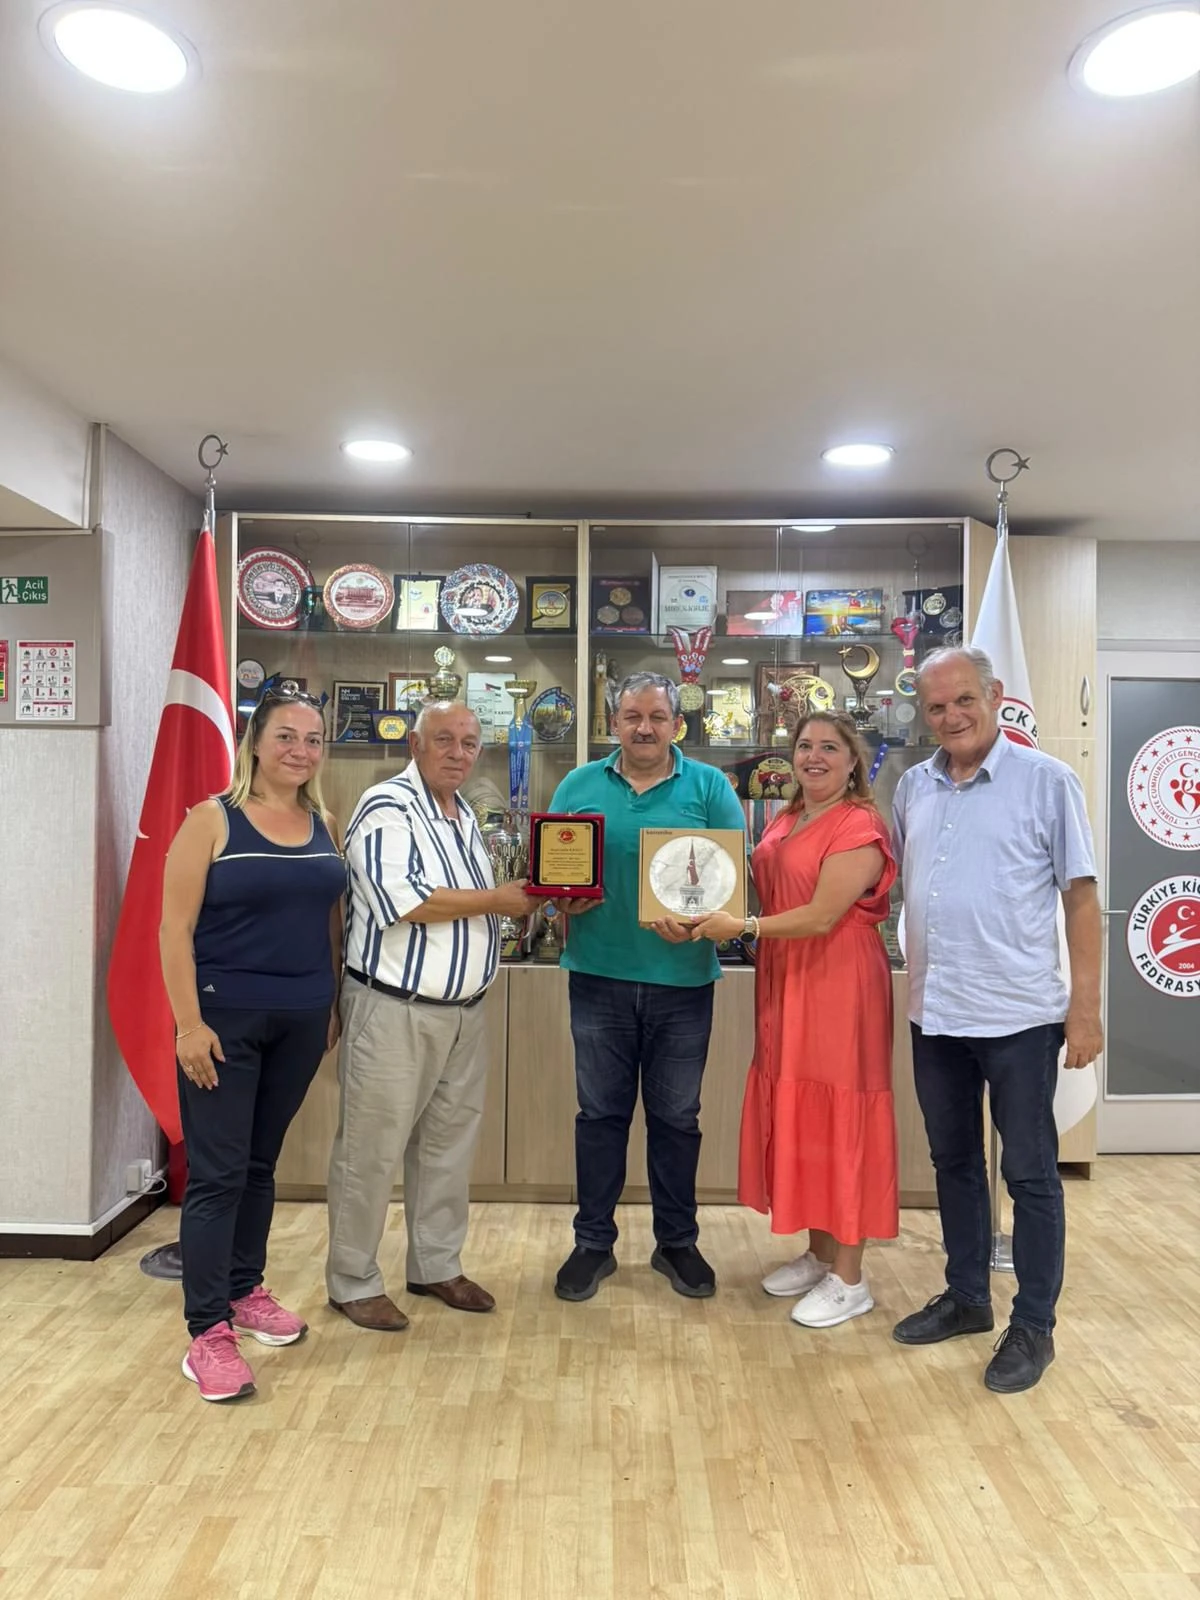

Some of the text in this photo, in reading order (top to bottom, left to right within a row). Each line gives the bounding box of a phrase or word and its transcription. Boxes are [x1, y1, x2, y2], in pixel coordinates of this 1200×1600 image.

[25, 580, 44, 589] Acil
[22, 591, 47, 601] Çıkış
[1133, 882, 1177, 931] TÜRKİYE
[1178, 962, 1195, 970] 2004
